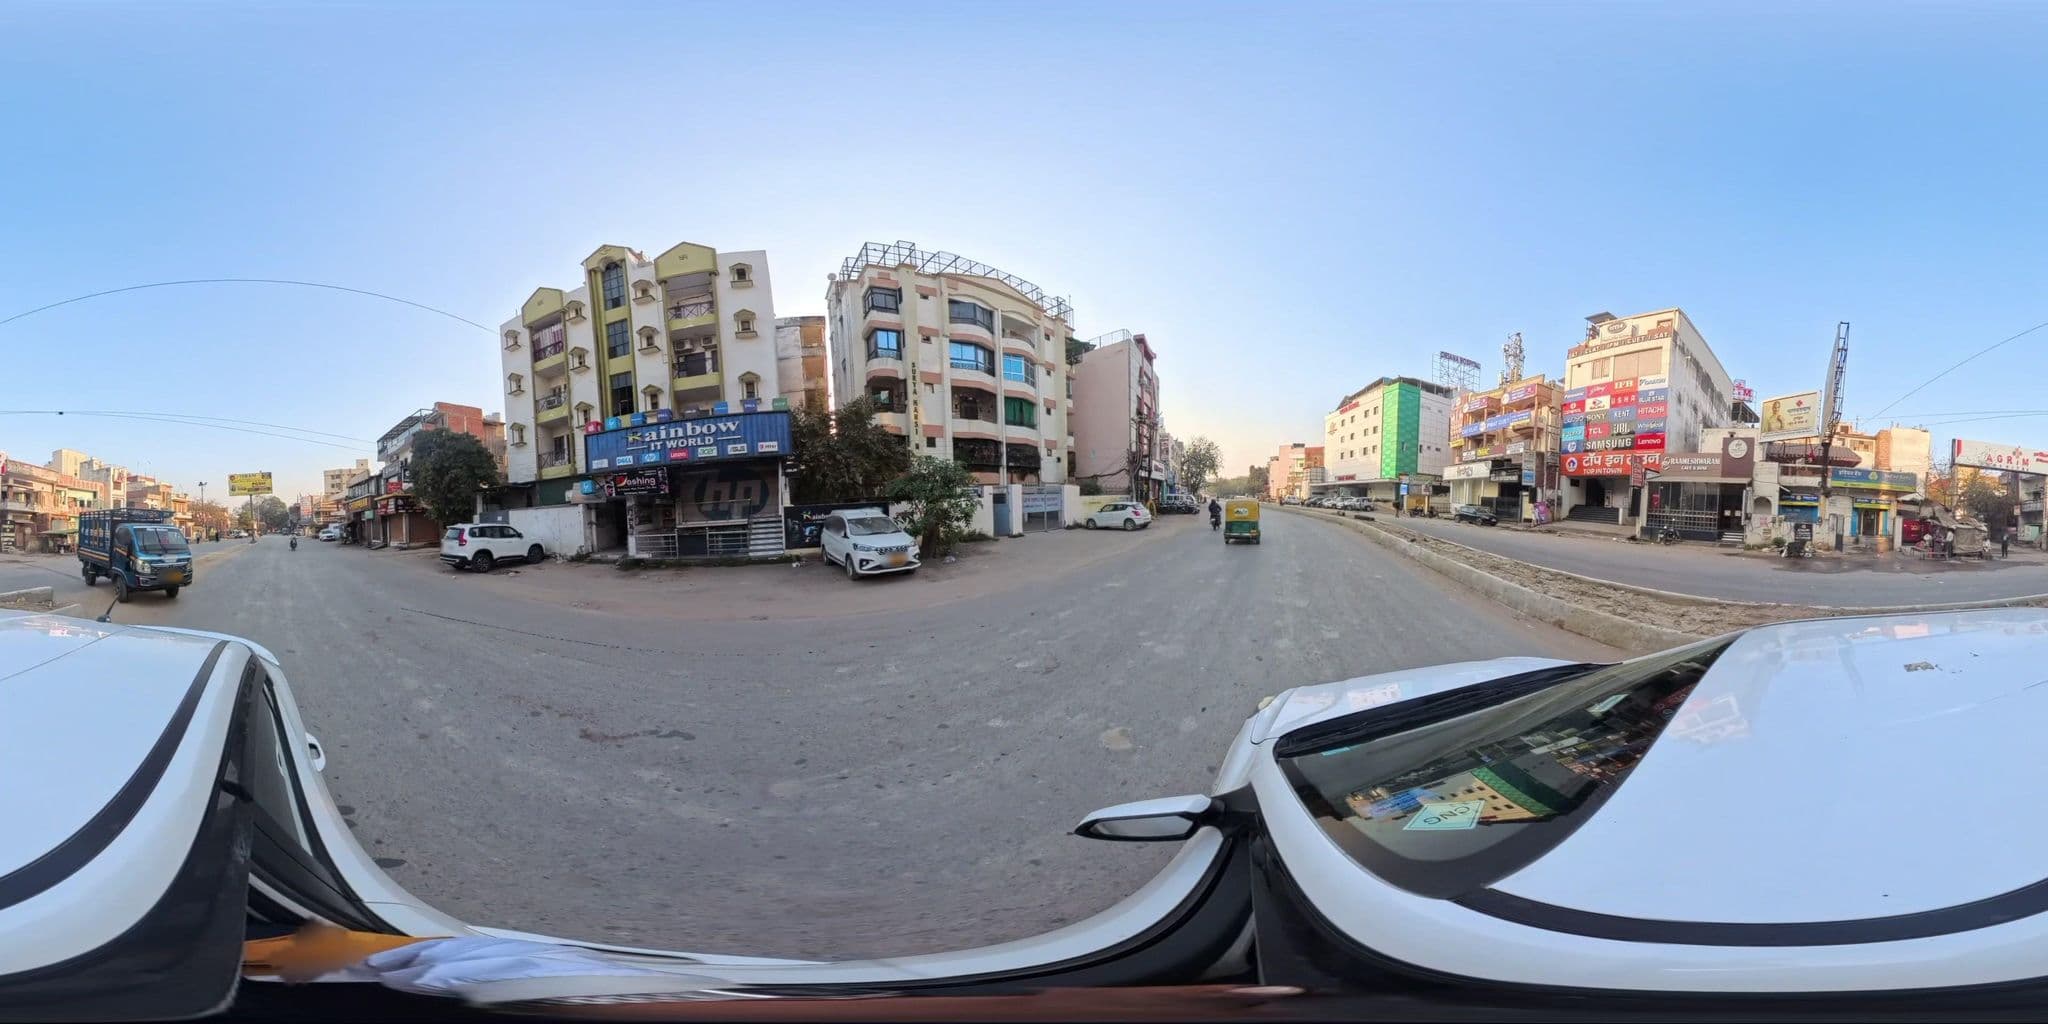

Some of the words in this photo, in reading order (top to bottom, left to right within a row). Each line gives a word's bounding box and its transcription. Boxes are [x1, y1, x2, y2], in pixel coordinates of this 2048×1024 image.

[1614, 410, 1630, 418] KENT
[1638, 405, 1665, 414] HITACHI
[1588, 426, 1603, 434] TCL
[650, 441, 664, 450] IT
[666, 436, 714, 449] WORLD
[1585, 438, 1632, 450] SAMSUNG
[1582, 452, 1602, 467] टॉप
[1605, 454, 1624, 467] इन
[1424, 806, 1470, 824] CNG
